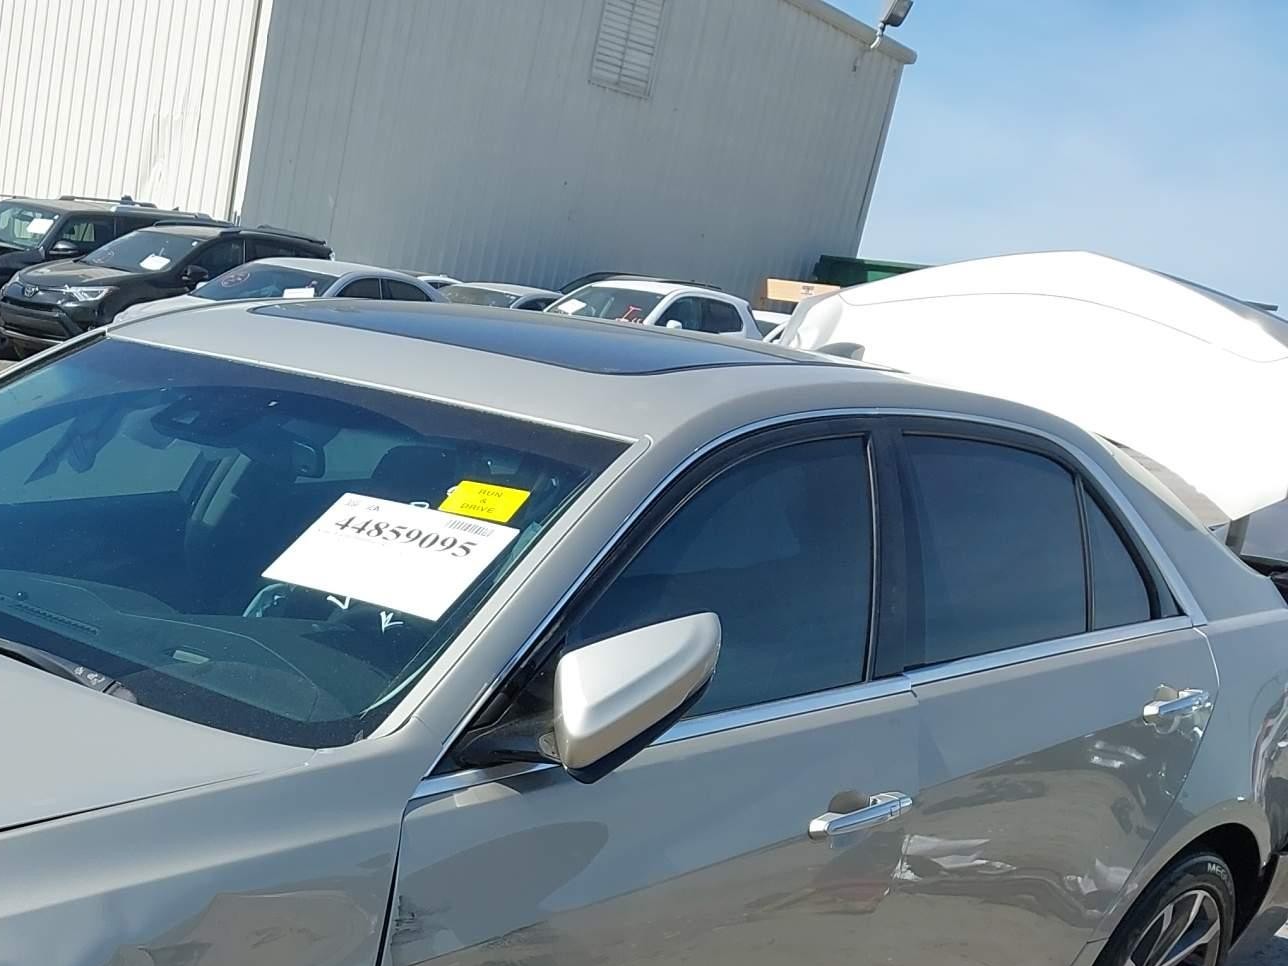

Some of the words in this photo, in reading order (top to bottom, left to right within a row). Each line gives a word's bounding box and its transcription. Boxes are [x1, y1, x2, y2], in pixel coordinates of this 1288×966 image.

[477, 488, 504, 498] RUN
[460, 502, 496, 514] DRIVE
[335, 515, 478, 558] 44859095
